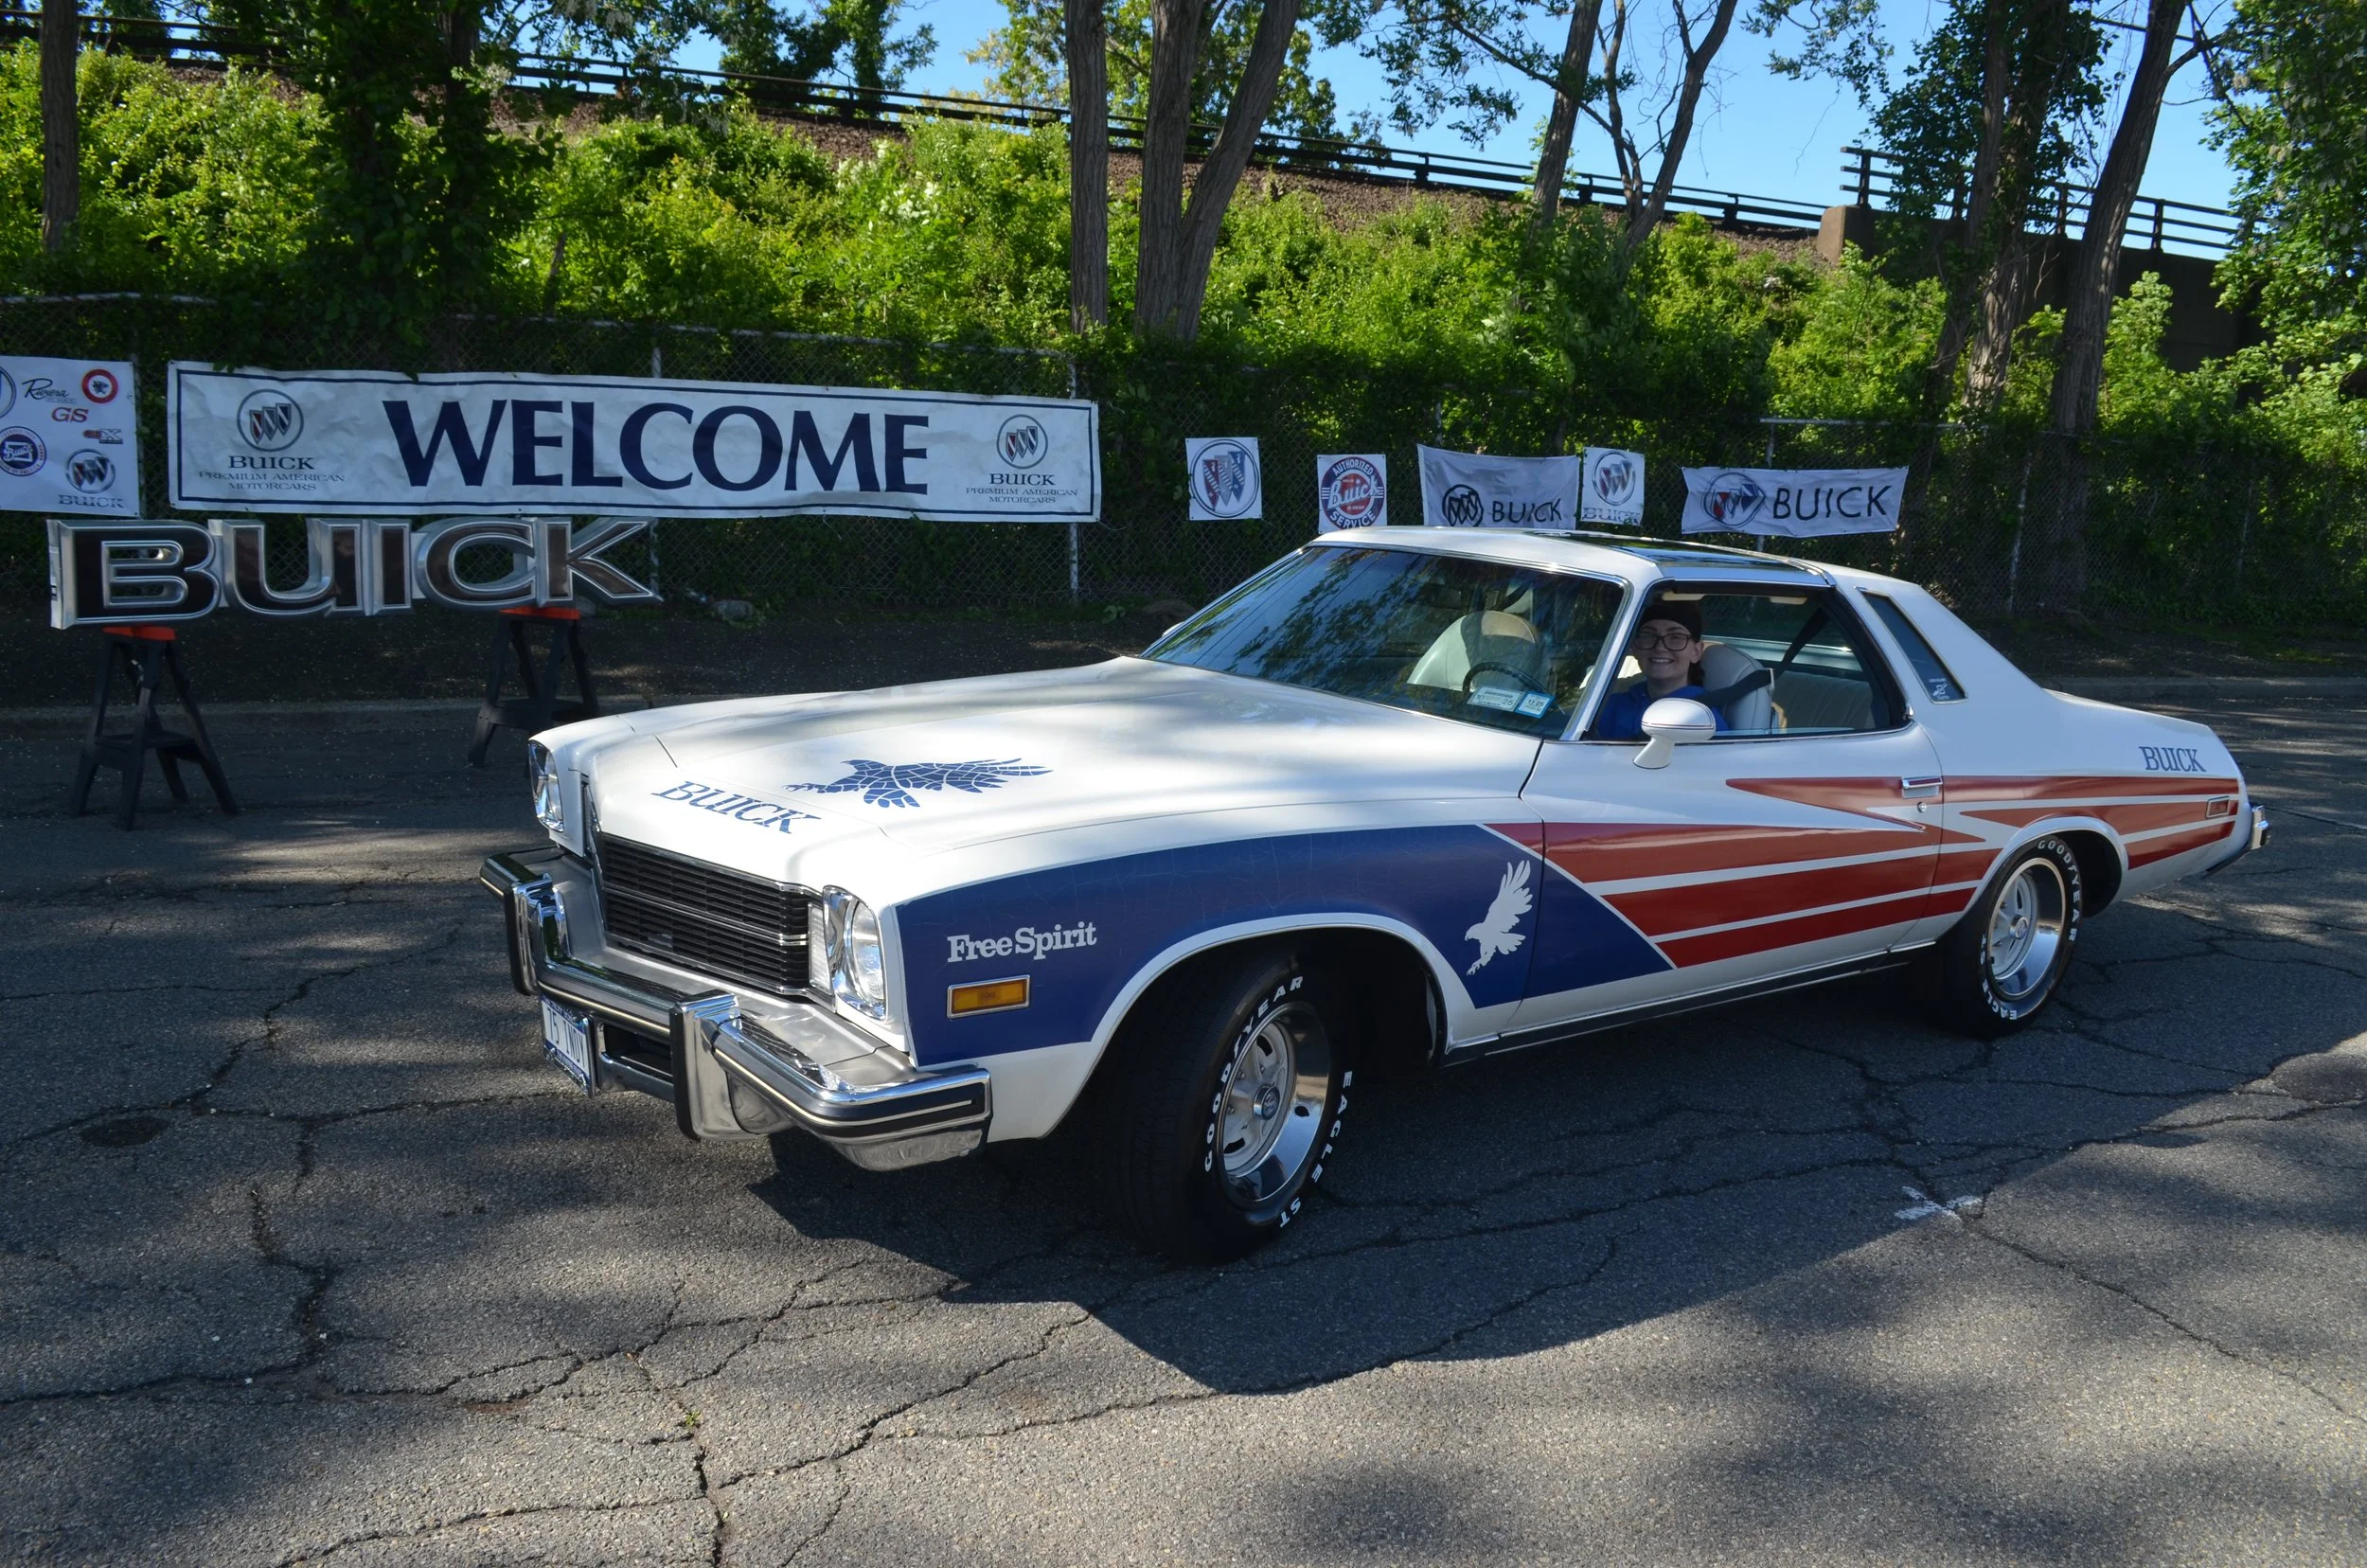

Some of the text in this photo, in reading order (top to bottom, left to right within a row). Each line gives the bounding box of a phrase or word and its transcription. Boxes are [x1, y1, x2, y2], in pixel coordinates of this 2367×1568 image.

[51, 406, 89, 422] GS
[382, 399, 930, 495] WELCOME
[228, 455, 315, 470] BUICK
[1332, 459, 1373, 476] AUTHORIZED
[198, 471, 345, 483] PREMIUM AMERICAN
[229, 482, 316, 491] MOTORCARS
[989, 473, 1056, 486] BUICK
[58, 494, 125, 508] BUICK
[966, 487, 1018, 495] PREMIUM
[1327, 475, 1380, 509] Buick
[1492, 498, 1562, 524] BUICK
[1773, 485, 1892, 521] BUICK
[1329, 509, 1376, 529] SERVICE
[1581, 507, 1640, 525] BUICK
[47, 518, 664, 630] BUICK
[2138, 746, 2207, 773] BUICK
[651, 780, 822, 834] BUICK
[2038, 839, 2081, 942] GOODYEAR
[1204, 975, 1304, 1172] GOODYEAR
[1279, 1070, 1353, 1228] EAGLE ST
